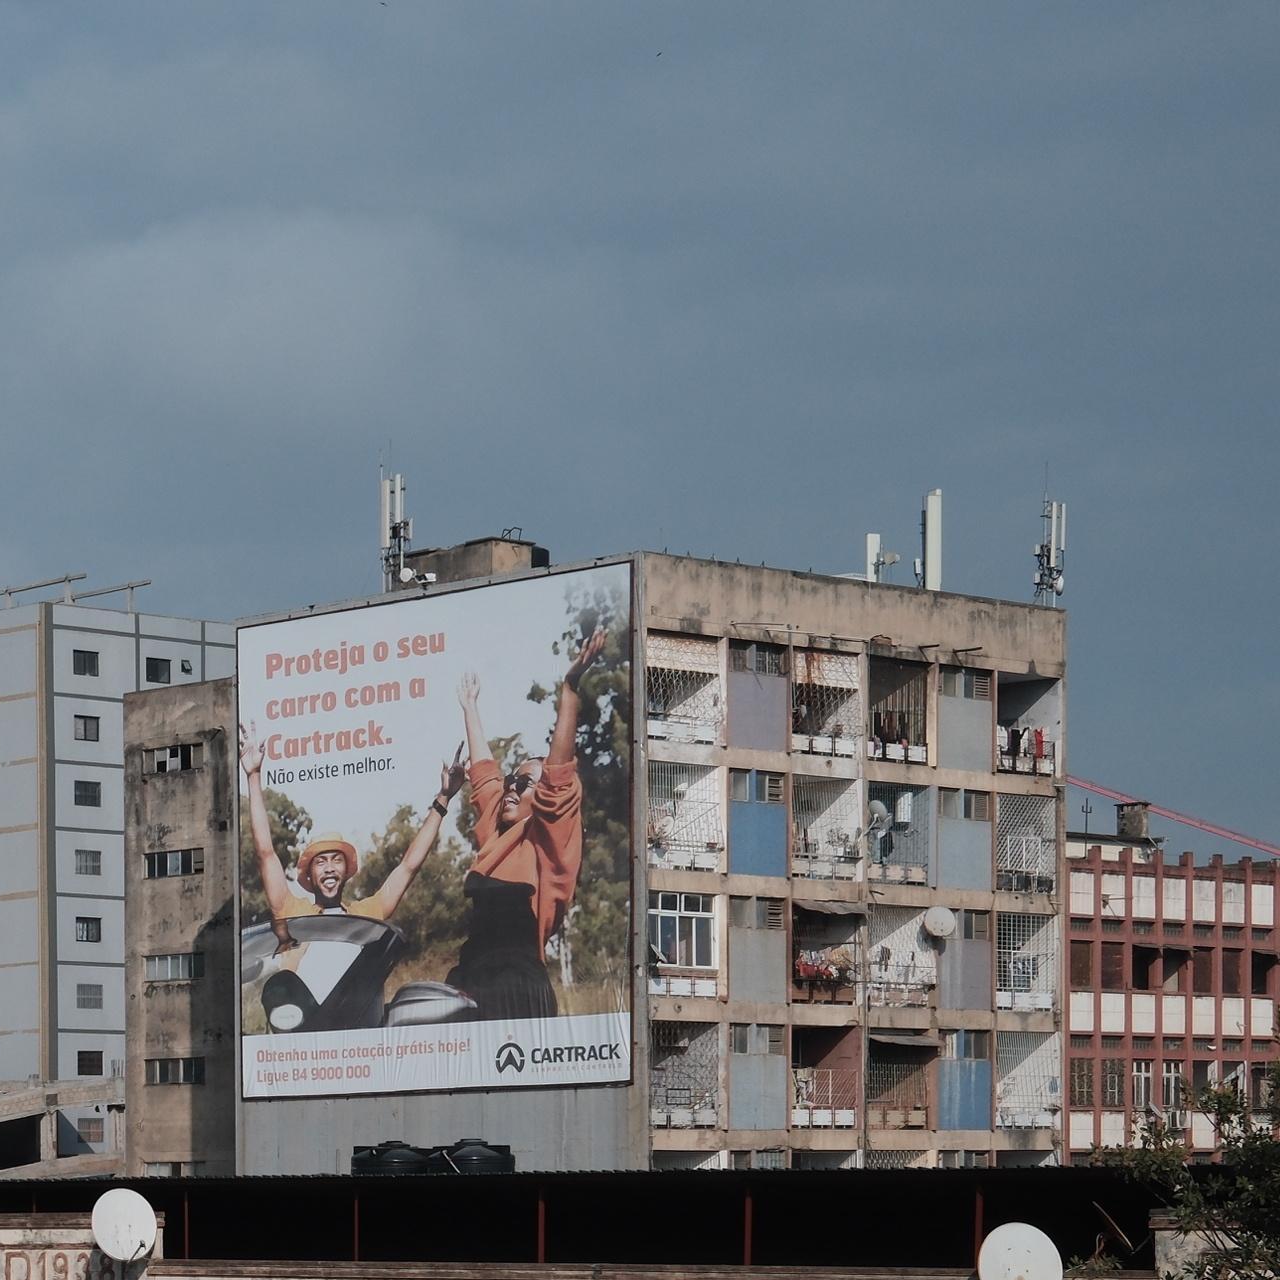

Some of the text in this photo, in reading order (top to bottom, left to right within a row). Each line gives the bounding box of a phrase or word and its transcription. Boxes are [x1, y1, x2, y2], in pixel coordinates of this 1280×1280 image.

[265, 632, 445, 680] Proteja o seu
[265, 677, 426, 720] carro com a
[267, 719, 393, 761] Cartrack.
[266, 757, 396, 786] Não existe melhor.
[256, 1038, 472, 1063] Obtenha uma cotação grátis hoje!
[531, 1043, 622, 1065] CARTRACK
[256, 1064, 371, 1086] Ligue 84 9000 000
